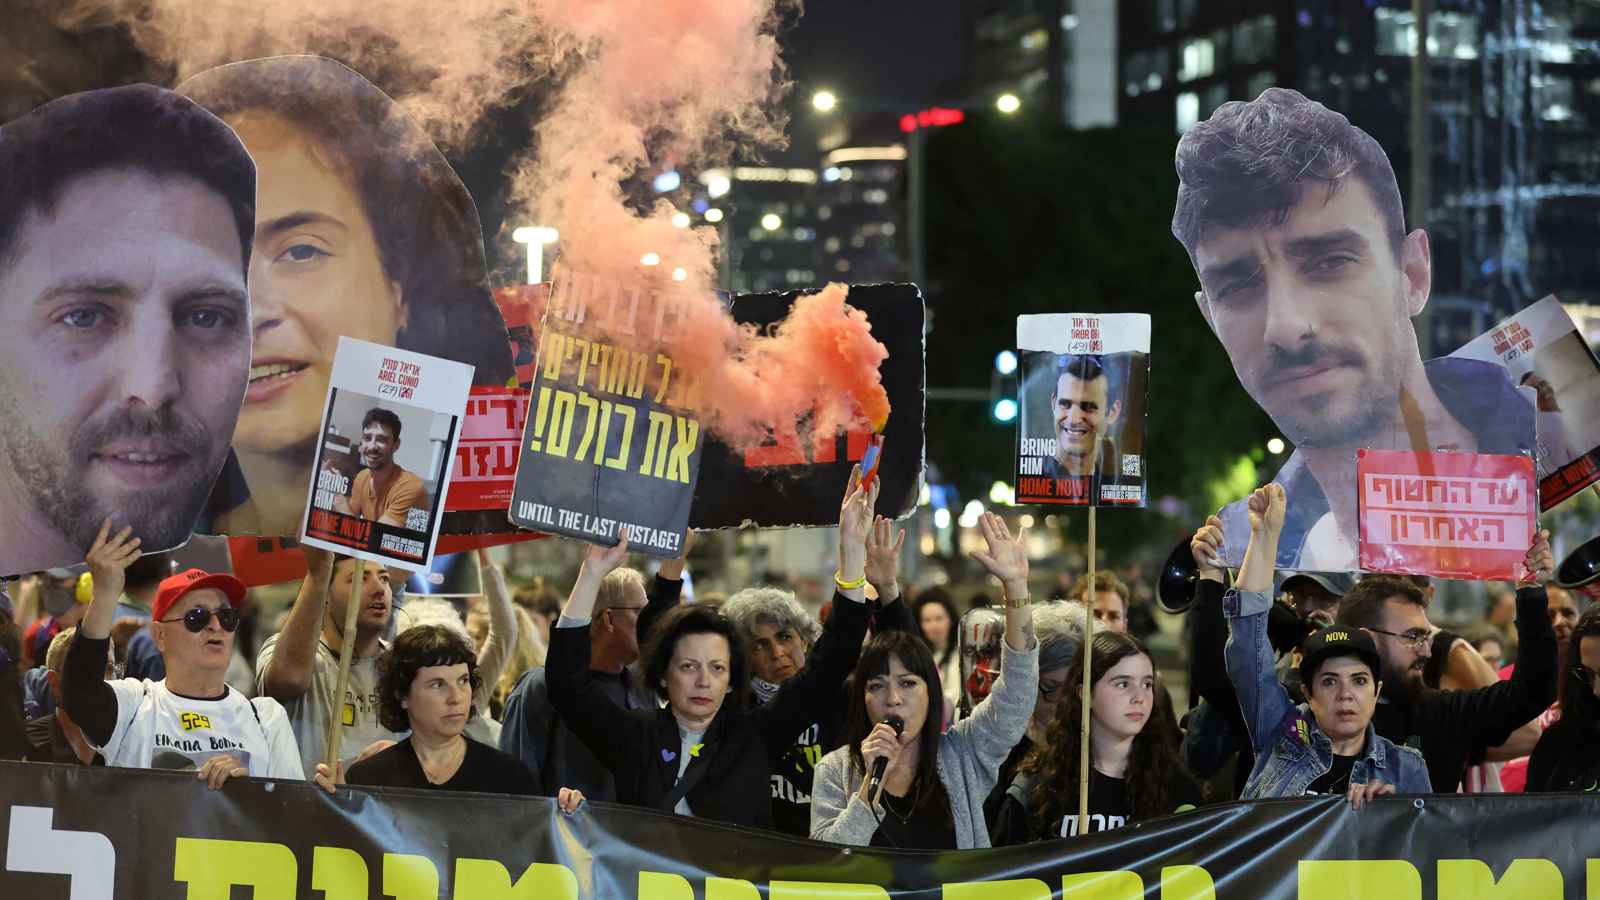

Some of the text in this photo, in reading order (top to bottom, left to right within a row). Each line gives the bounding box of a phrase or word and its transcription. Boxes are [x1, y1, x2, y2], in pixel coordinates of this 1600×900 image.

[378, 369, 396, 383] ARIEL
[543, 332, 648, 399] מחזירים
[378, 382, 398, 397] (27)
[531, 387, 636, 470] כולם!
[640, 411, 699, 483] את
[1020, 438, 1056, 456] BRING
[1020, 457, 1042, 475] HIM
[317, 470, 349, 494] BRING
[1019, 477, 1088, 496] HOME NOW!
[1372, 478, 1518, 505] עד החטוף
[314, 490, 334, 510] HIM
[311, 510, 371, 540] HOME NOW!
[518, 500, 554, 525] UNTIL
[558, 509, 581, 530] THE
[583, 515, 616, 538] LAST
[1391, 514, 1504, 542] האחרון
[1325, 631, 1350, 643] NOW.
[181, 712, 210, 730] 529
